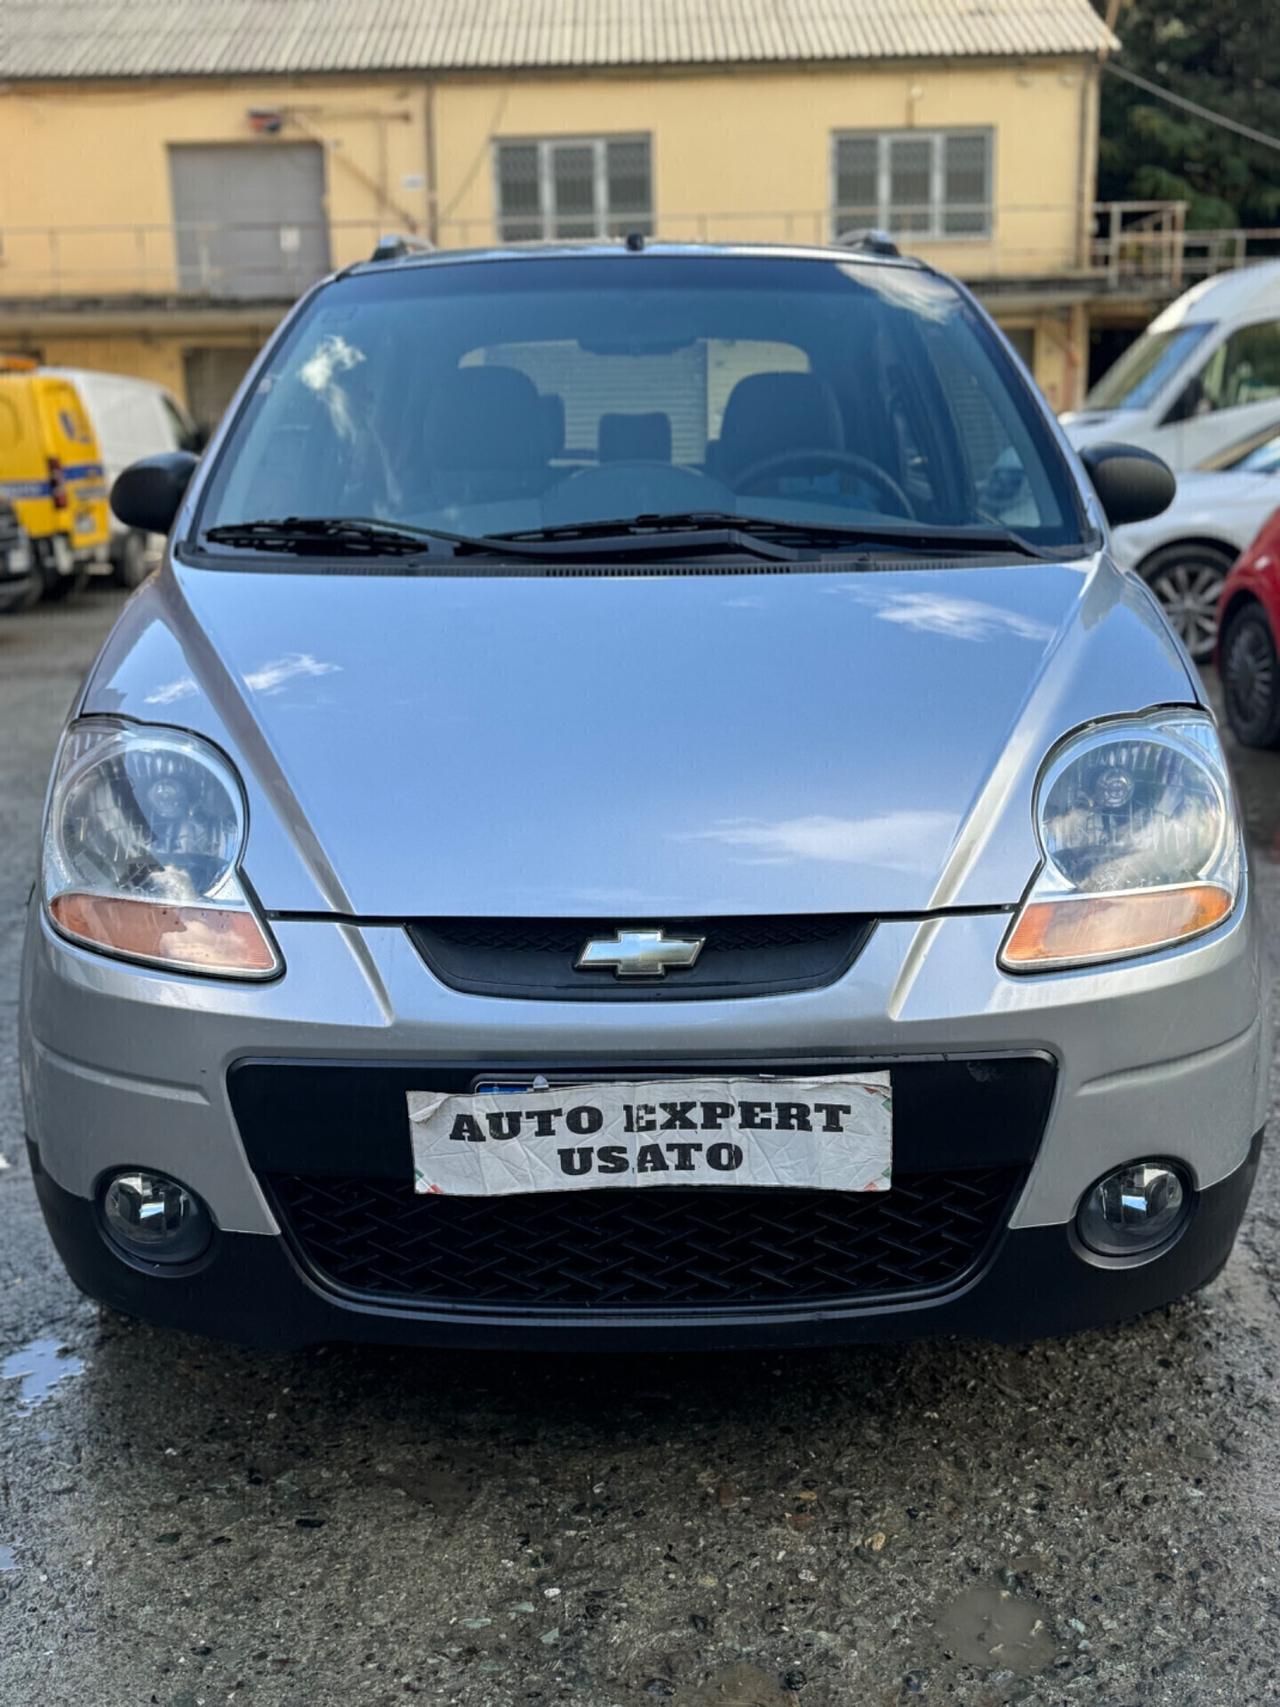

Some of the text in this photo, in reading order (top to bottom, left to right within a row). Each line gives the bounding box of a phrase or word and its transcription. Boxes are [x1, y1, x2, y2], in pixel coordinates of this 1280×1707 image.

[450, 1101, 852, 1143] AUTO EXPERT
[557, 1142, 744, 1176] USATO
